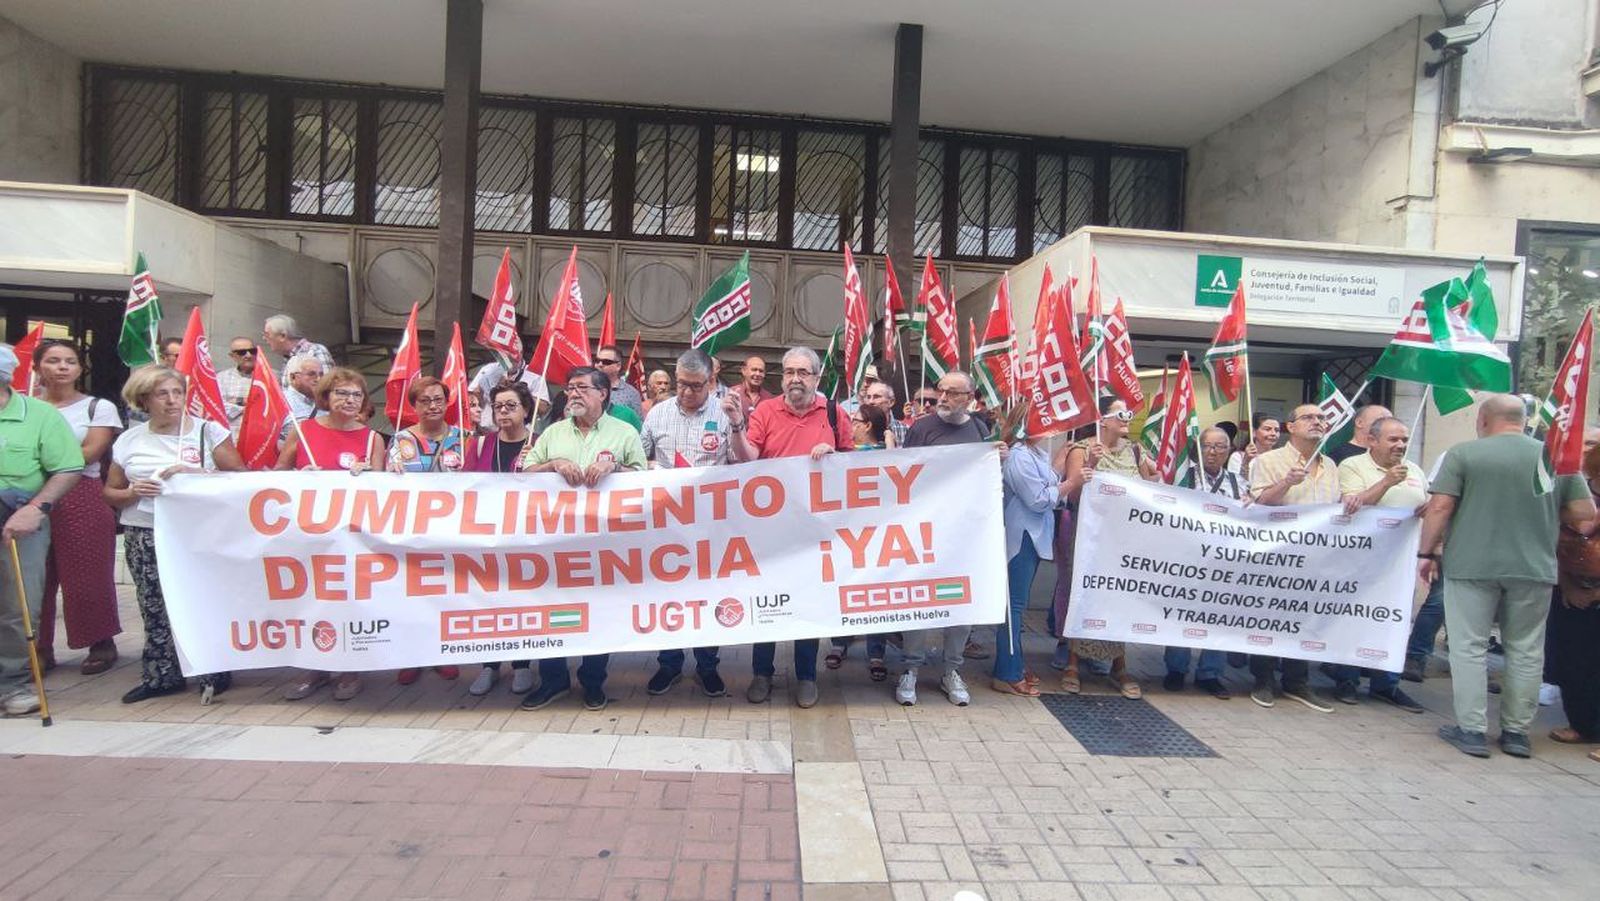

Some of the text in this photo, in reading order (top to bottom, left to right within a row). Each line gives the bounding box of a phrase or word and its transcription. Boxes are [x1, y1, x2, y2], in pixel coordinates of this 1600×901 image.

[1250, 269, 1378, 287] Consejería de Inclusión Social,
[1250, 281, 1293, 292] Juventud,
[1295, 283, 1330, 293] Familias
[1338, 285, 1376, 297] Igualdad
[1114, 361, 1144, 402] Huelva
[249, 464, 925, 536] CUMPLIMIENTO LEY
[1128, 508, 1373, 550] POR UNA FINANCIACION JUSTA
[263, 522, 936, 601] DEPENDENCIA ¡YA!
[1201, 543, 1305, 569] Y SUFICIENTE
[1120, 554, 1358, 595] SERVICIOS DE ATENCION A LAS
[756, 594, 790, 608] UJP
[846, 585, 930, 608] CCOO
[1082, 574, 1403, 623] DEPENDENCIAS DIGNOS PARA USUARI@S
[350, 619, 390, 635] UJP
[448, 611, 542, 635] CCOO
[632, 599, 708, 634] UGT
[841, 609, 950, 627] Pensionistas Huelva
[1162, 606, 1173, 620] Y
[1177, 608, 1301, 634] TRABAJADORAS
[231, 619, 306, 652] UGT
[441, 637, 564, 654] Pensionistas Huelva
